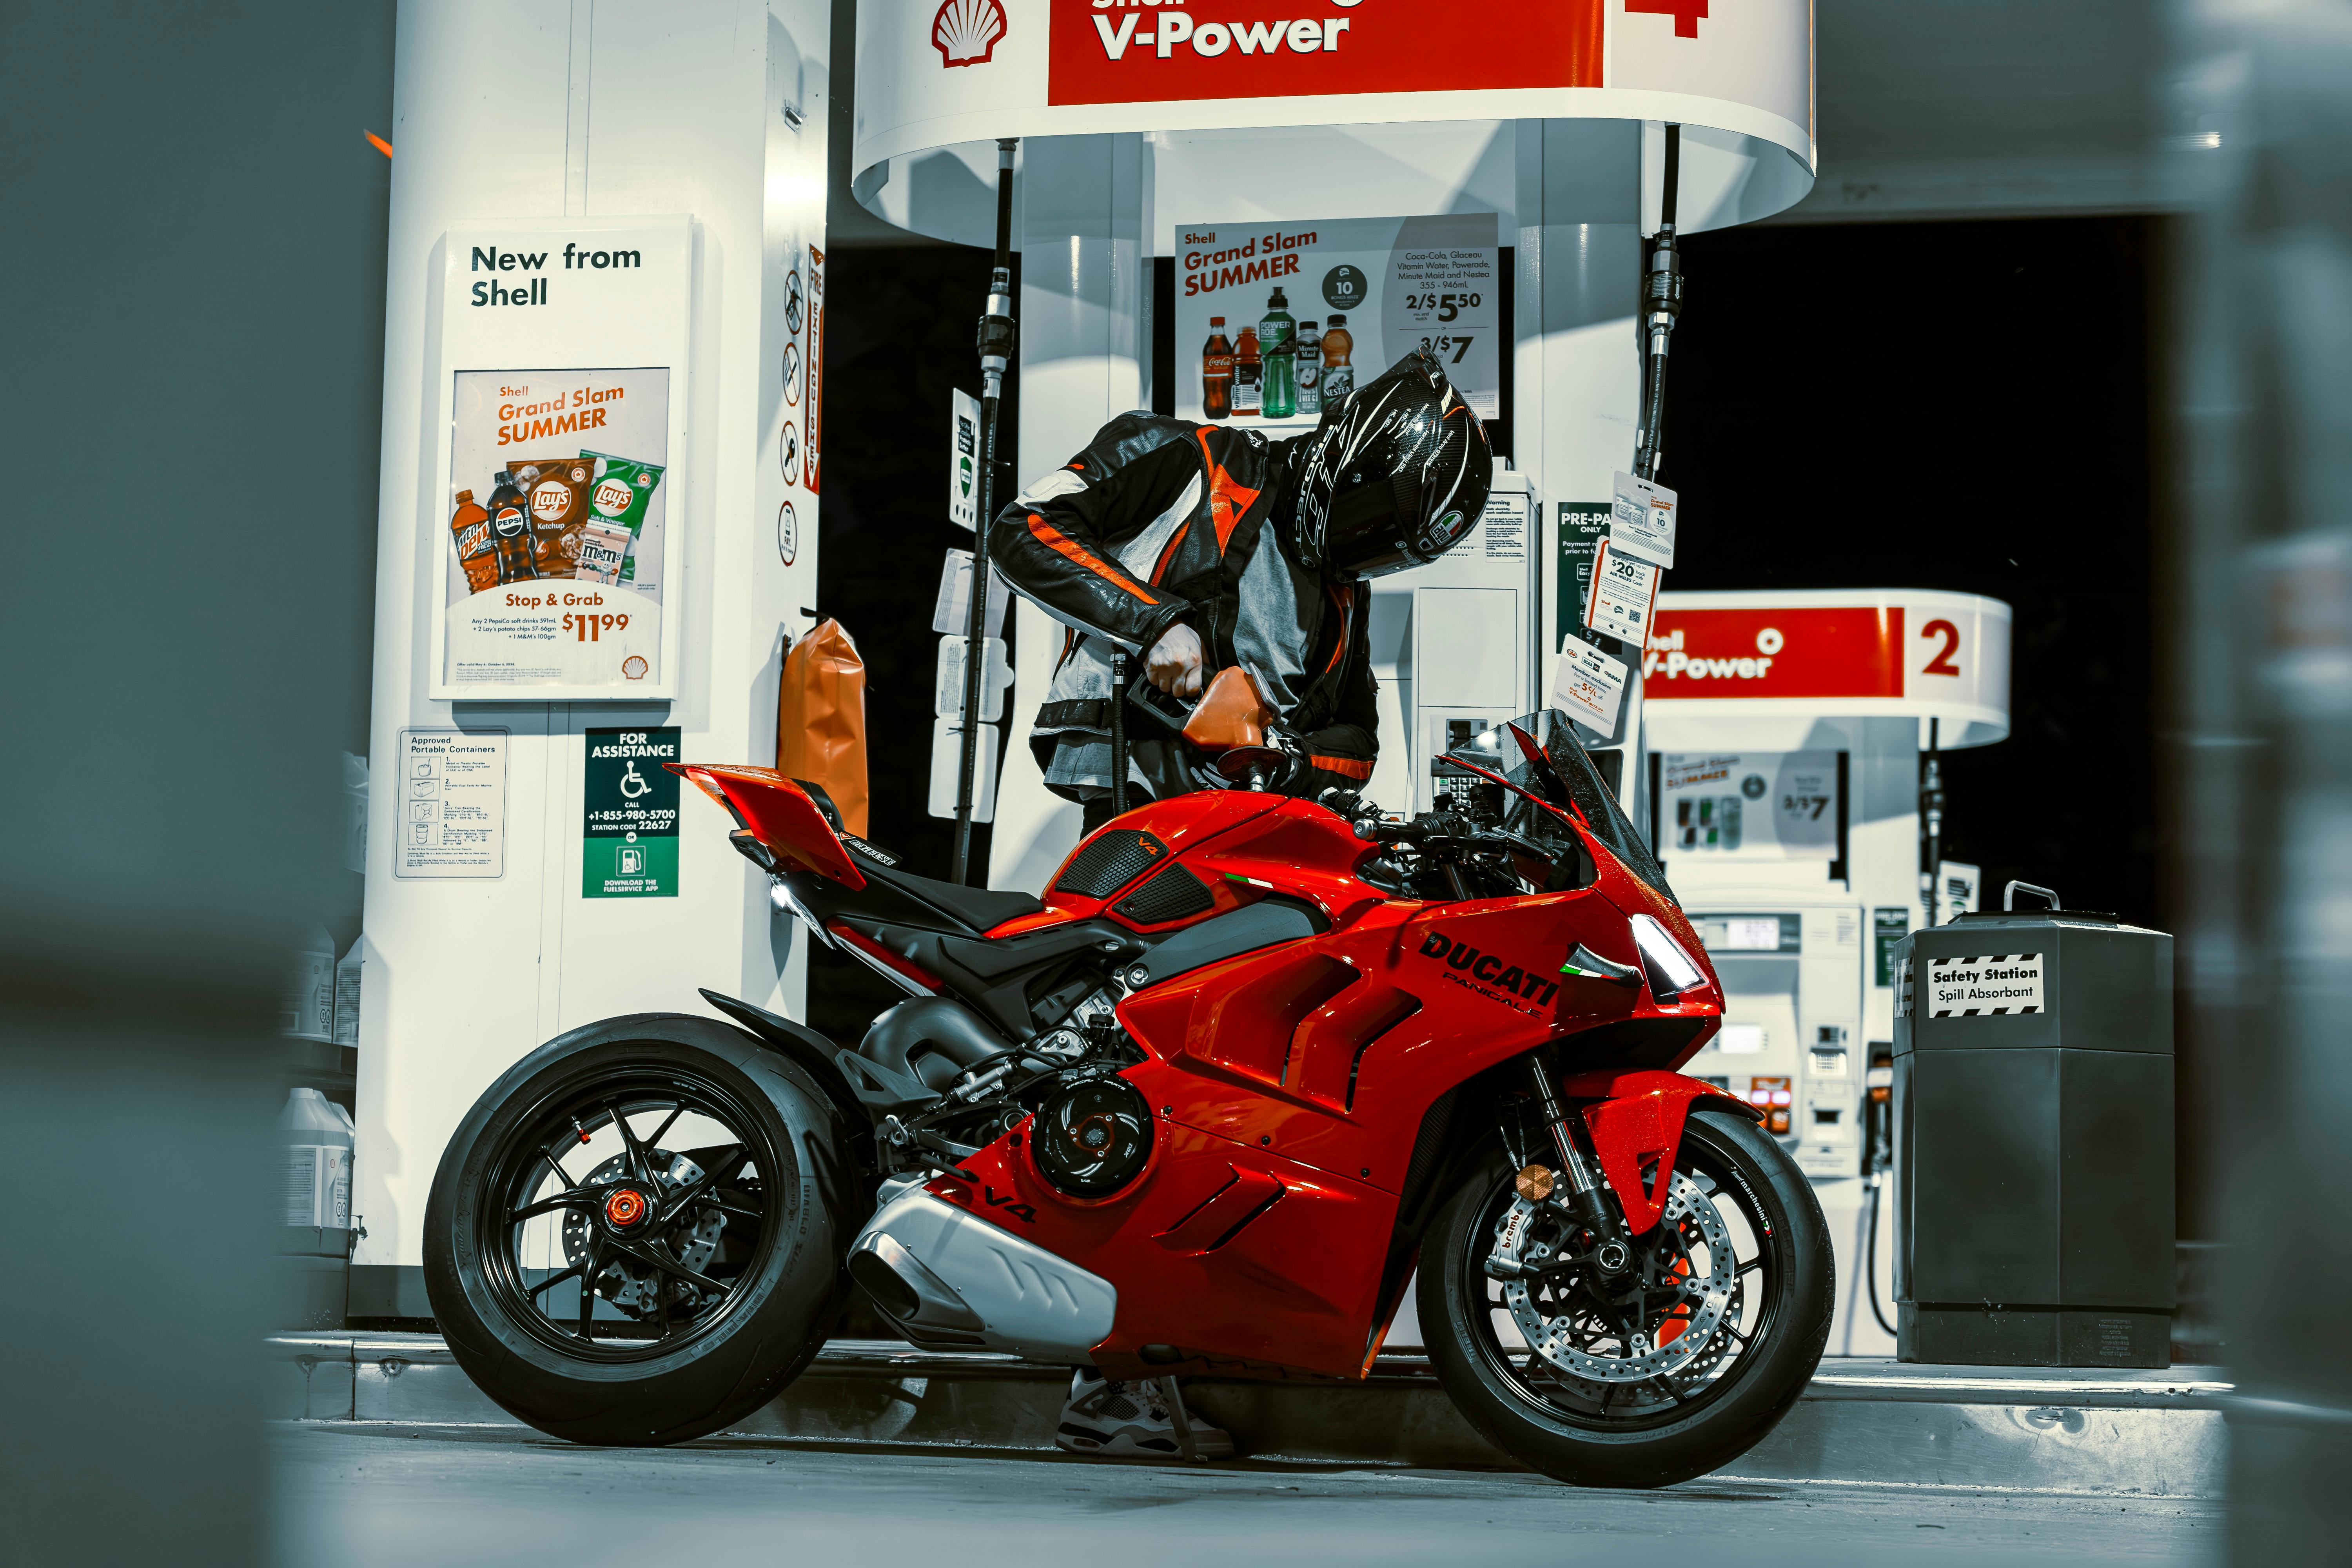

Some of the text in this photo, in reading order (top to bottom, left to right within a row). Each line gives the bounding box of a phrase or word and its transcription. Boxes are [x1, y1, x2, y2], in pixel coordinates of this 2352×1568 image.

[1091, 11, 1350, 61] V-Power
[1185, 232, 1215, 244] Shell
[472, 243, 640, 271] New from
[1184, 231, 1317, 271] Grand Slam
[811, 267, 822, 296] FIRE
[1184, 252, 1301, 297] SUMMER
[471, 278, 547, 307] Shell
[1336, 282, 1353, 294] 10
[499, 386, 528, 396] Shell
[809, 302, 819, 474] EXTINGUISHER
[1324, 387, 1351, 398] NESTEA
[498, 387, 624, 421] Grand Slam
[497, 408, 607, 446] SUMMER
[1296, 425, 1334, 548] PROJECT
[497, 517, 521, 527] PEPSI
[537, 522, 564, 530] Ketchup
[1561, 513, 1612, 525] PRE-PA
[1657, 518, 1665, 526] 10
[1612, 559, 1634, 577] $20
[506, 592, 603, 609] Stop & Grab
[1648, 630, 1684, 651] hell
[1920, 618, 1960, 677] 2
[1572, 664, 1612, 690] Member exclusive
[1608, 673, 1622, 684] AMA
[1569, 690, 1589, 703] V-Power
[620, 733, 647, 744] FOR
[592, 745, 674, 758] ASSISTANCE
[589, 809, 675, 820] +1-855-980-5700
[639, 821, 671, 829] 22627
[849, 839, 896, 866] DAINESE
[1138, 836, 1157, 855] V4
[1418, 931, 1560, 1007] DUCATI
[1933, 967, 2038, 984] Safety Station
[1442, 972, 1543, 1019] PANIGALE
[1939, 987, 2033, 1003] Spill Absorbant
[985, 1186, 1036, 1224] V4
[1740, 1181, 1767, 1221] marchesini
[1502, 1209, 1523, 1248] brembo
